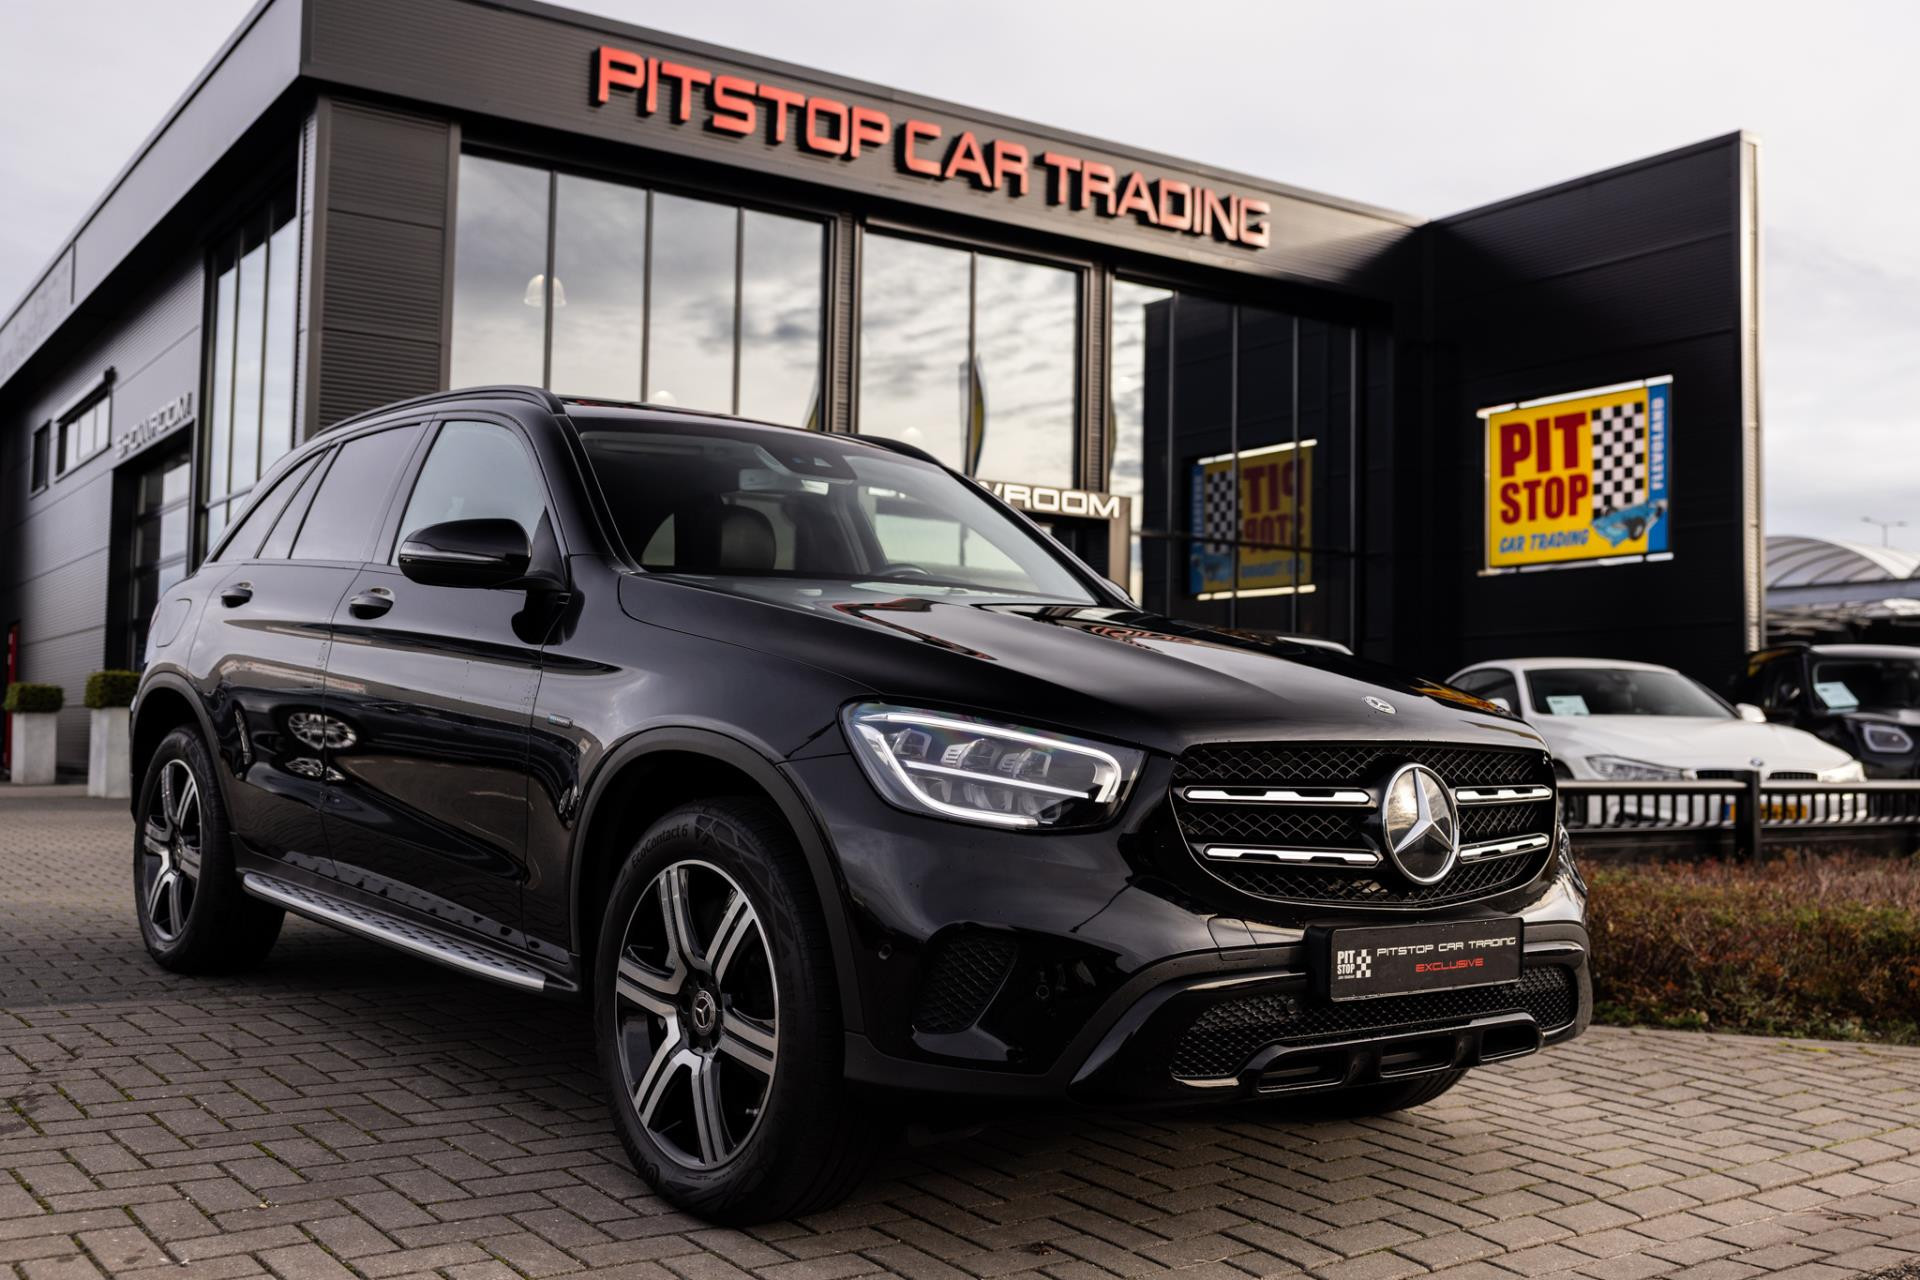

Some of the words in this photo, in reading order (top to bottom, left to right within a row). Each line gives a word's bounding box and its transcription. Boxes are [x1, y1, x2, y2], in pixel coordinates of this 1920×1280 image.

[598, 45, 891, 158] PITSTOP
[903, 118, 1028, 195] CAR
[1042, 151, 1270, 249] TRADING
[1500, 411, 1587, 478] PIT
[1500, 473, 1588, 525] STOP
[1499, 535, 1525, 553] CAR
[1530, 529, 1589, 551] TRADING
[631, 825, 680, 867] EcoContact
[682, 824, 688, 838] 6
[1337, 950, 1356, 964] PIT
[1376, 944, 1434, 957] PITSTOP
[1438, 941, 1464, 952] CAR
[1468, 937, 1516, 949] TRADING
[1337, 964, 1356, 975] STOP
[1415, 958, 1484, 973] EXCLUSIVE
